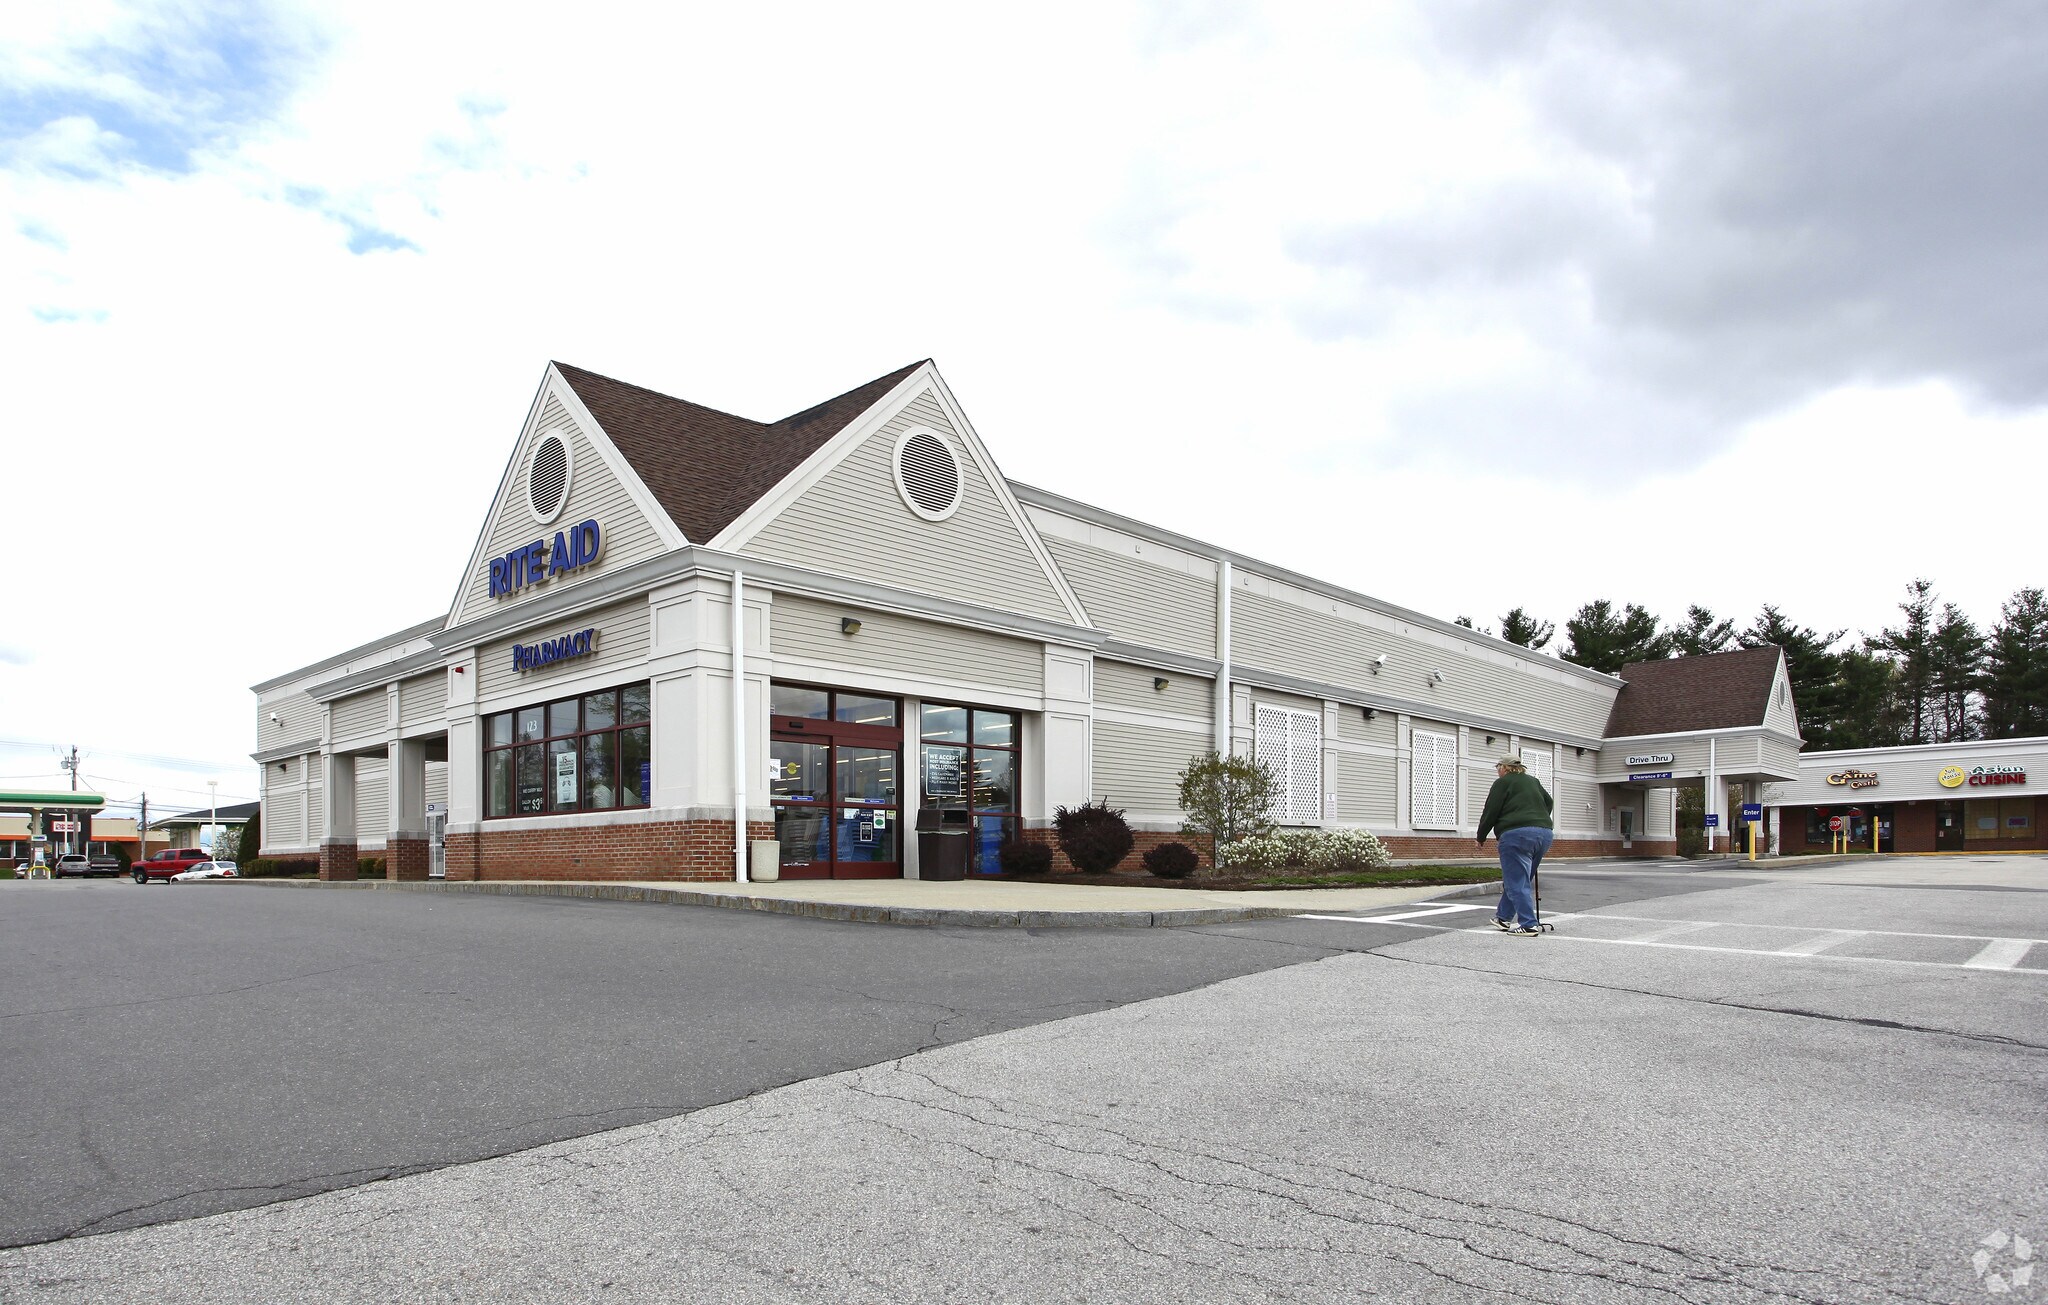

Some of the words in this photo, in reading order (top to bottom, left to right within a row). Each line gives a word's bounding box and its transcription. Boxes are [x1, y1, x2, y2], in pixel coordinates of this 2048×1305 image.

[489, 539, 546, 599] RITE
[548, 518, 602, 577] AID
[512, 628, 596, 673] PHARMACY
[527, 720, 538, 732] 123
[1630, 756, 1649, 764] Drive
[1970, 765, 2024, 774] Asian
[1826, 771, 1877, 786] Game
[1850, 780, 1879, 789] Castle
[1969, 774, 2027, 786] CUISINE
